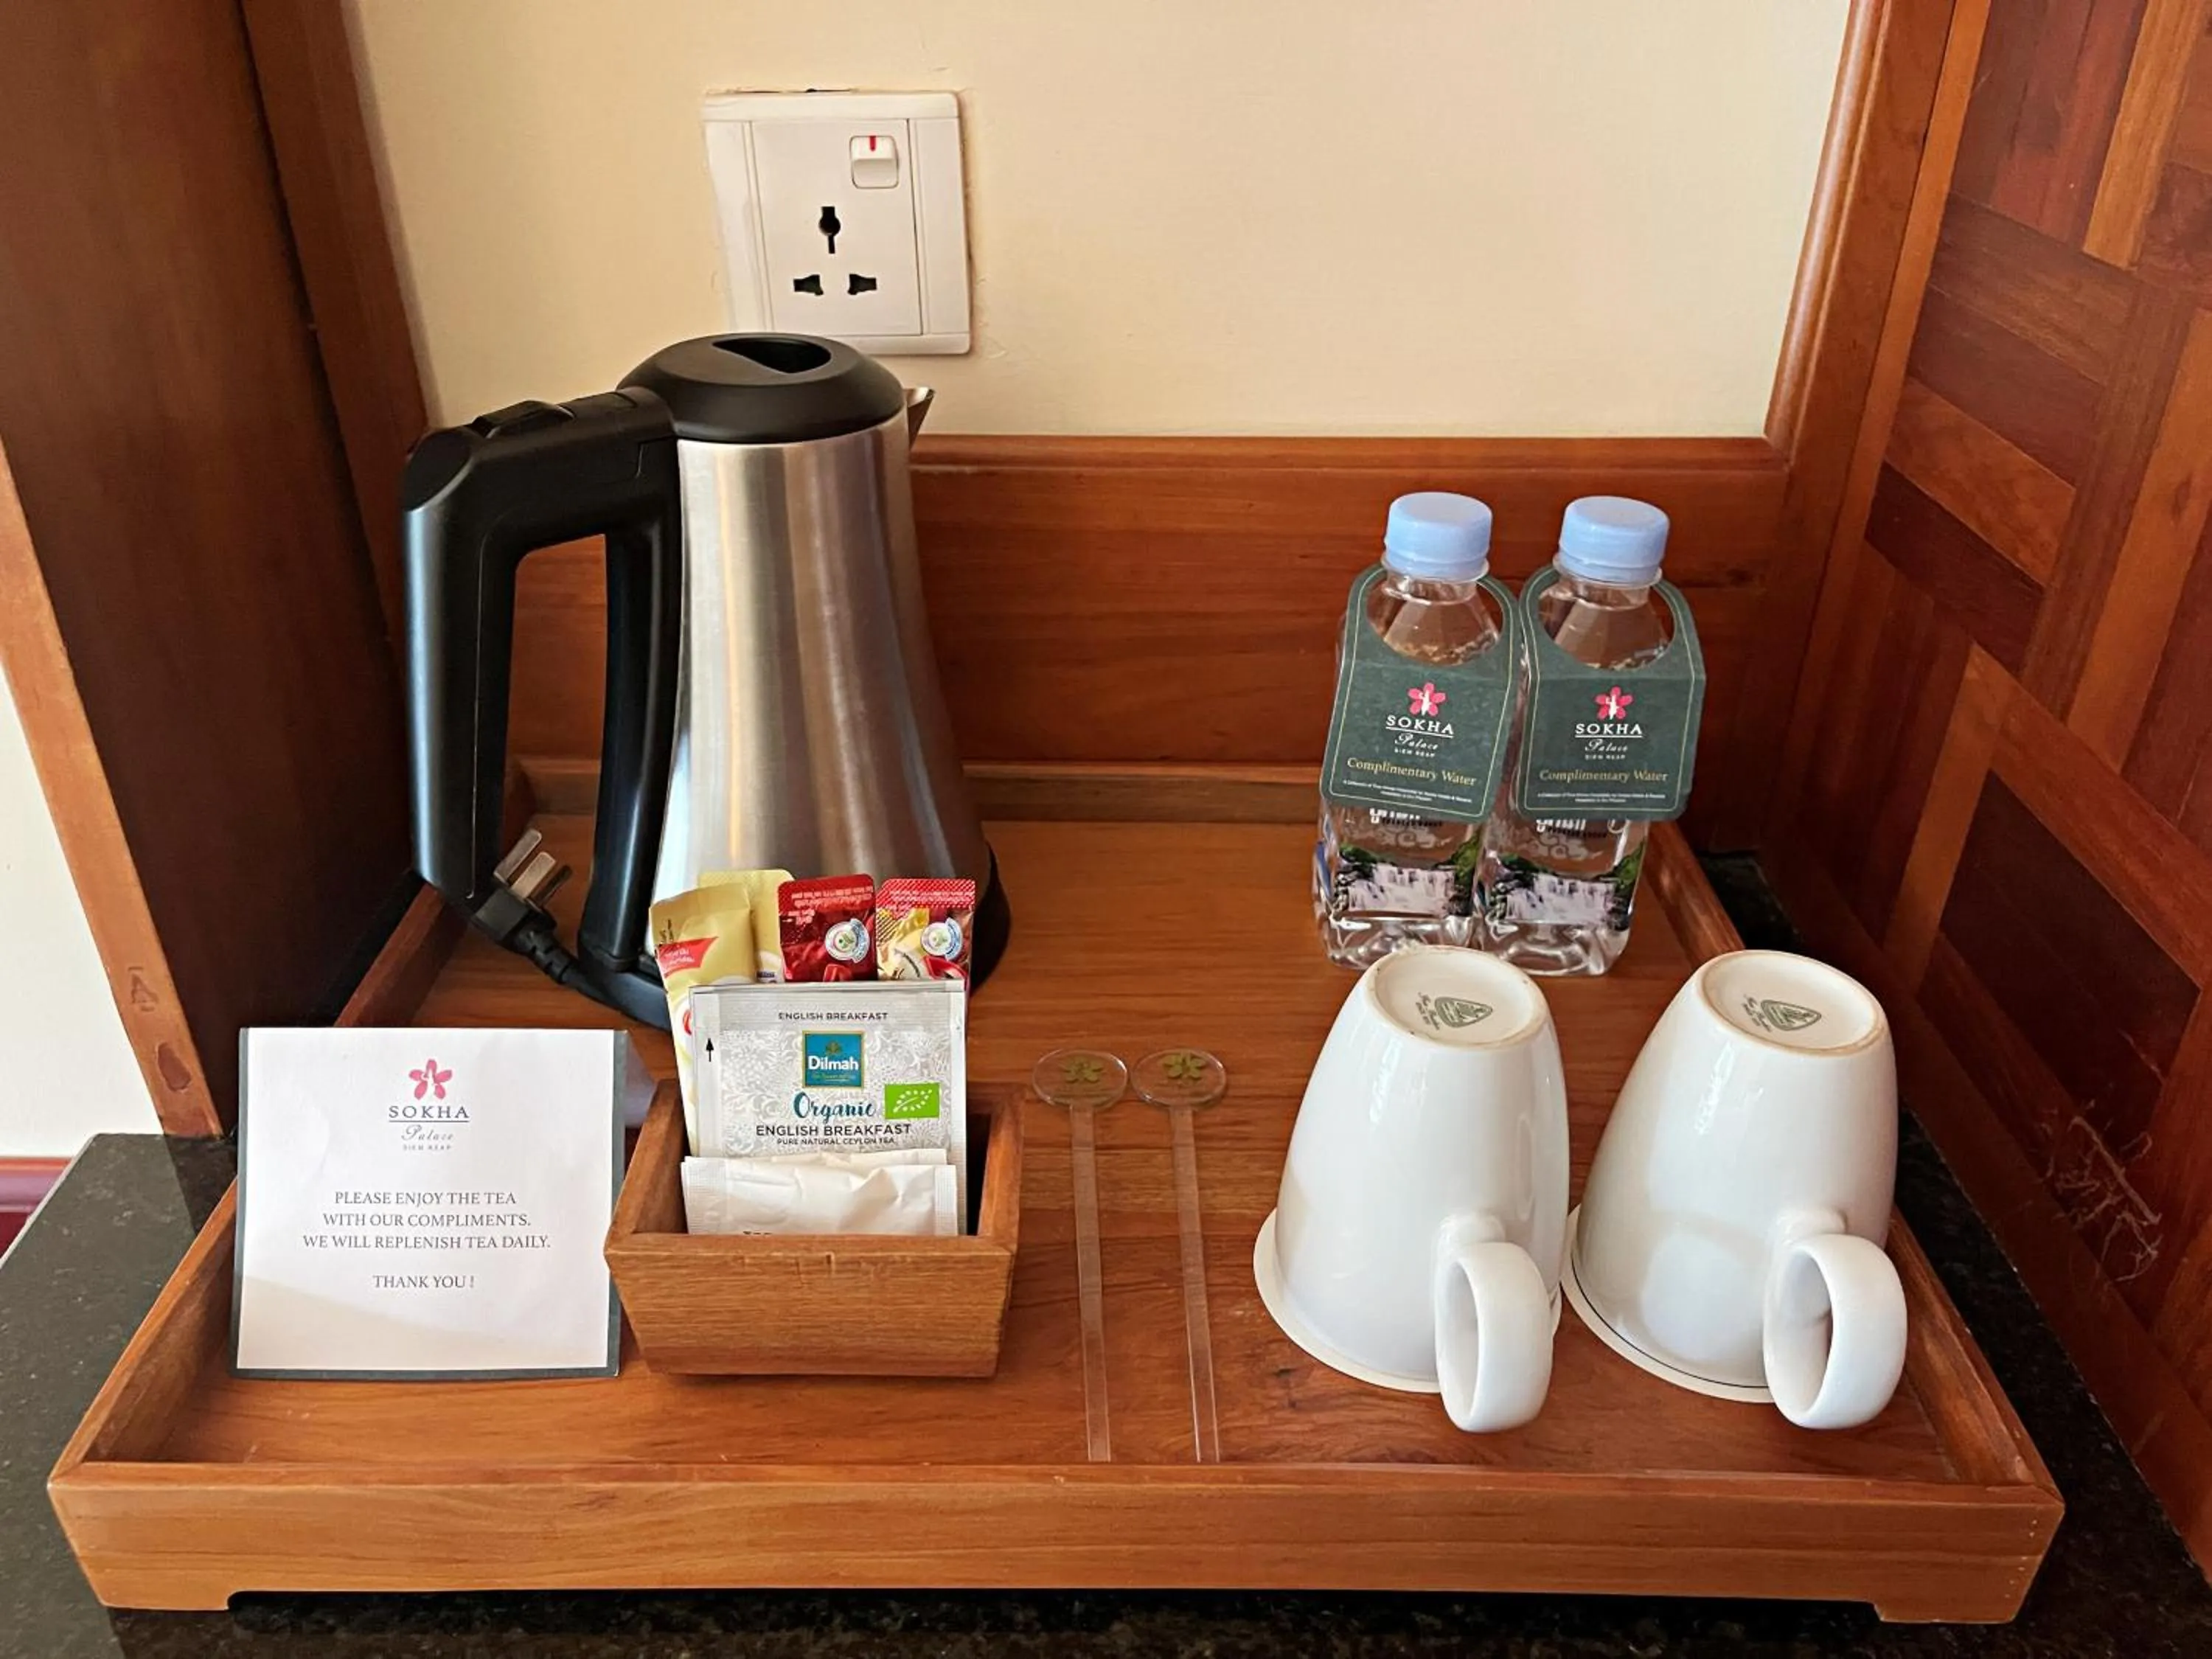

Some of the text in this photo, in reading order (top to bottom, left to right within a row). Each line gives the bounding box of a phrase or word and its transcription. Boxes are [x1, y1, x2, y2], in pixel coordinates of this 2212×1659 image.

[1386, 714, 1454, 735] SOKHA
[1575, 723, 1643, 734] SOKHA
[1347, 757, 1477, 786] Complimentary Water
[1540, 770, 1668, 783] Complimentary Water
[779, 1012, 888, 1020] ENGLISH BREAKFAST
[808, 1055, 859, 1070] Dilmah
[389, 1105, 470, 1119] SOKHA
[794, 1092, 876, 1124] Organic
[401, 1124, 453, 1141] Palace
[756, 1124, 911, 1136] ENGLISH BREAKFAST
[335, 1192, 516, 1207] PLEASE ENJOY THE TEA
[323, 1213, 531, 1227] WITH OUR COMPLIMENTS.
[303, 1235, 551, 1248] WE WILL REPLENISH TEA DAILY.
[372, 1275, 428, 1288] THANK
